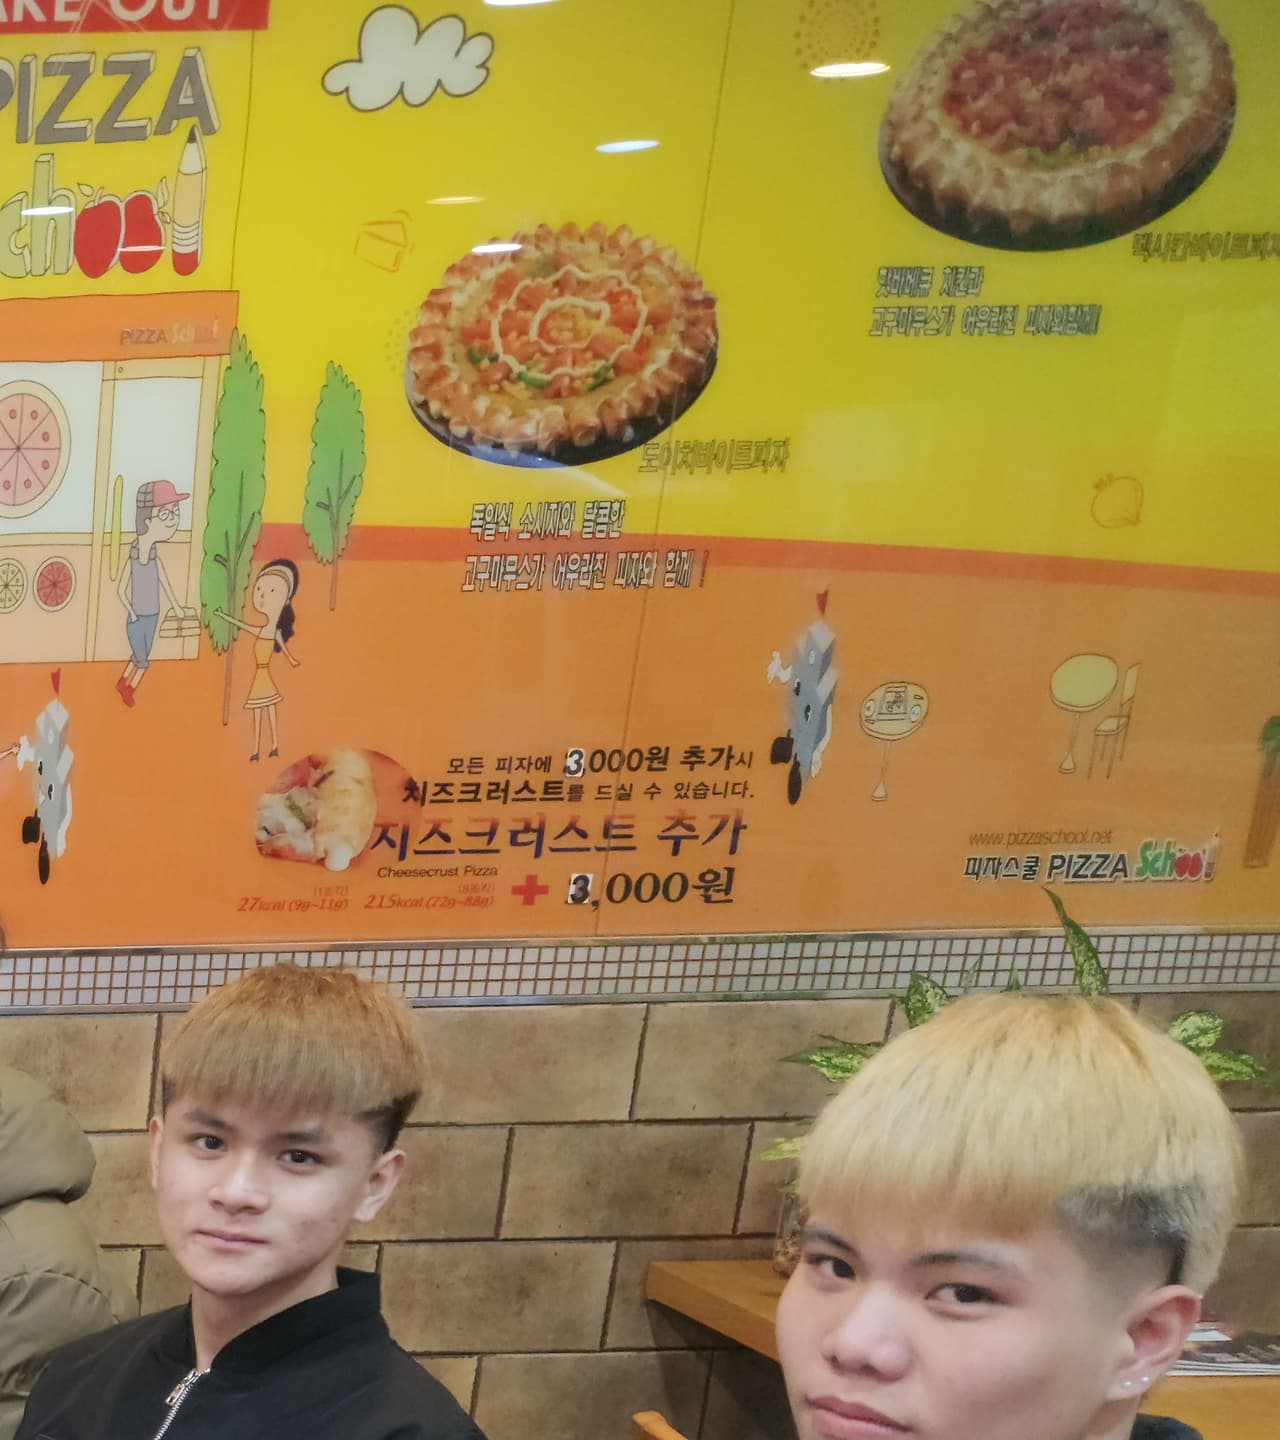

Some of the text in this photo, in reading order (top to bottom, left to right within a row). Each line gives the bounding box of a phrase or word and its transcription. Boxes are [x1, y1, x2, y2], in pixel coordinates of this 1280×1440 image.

[939, 266, 984, 297] 치킨과
[869, 305, 955, 336] 고구마무스가
[961, 305, 1019, 336] 어우러진
[119, 328, 167, 346] PIZZA
[638, 437, 790, 475] 도이치바이트피자
[469, 499, 626, 541] 독일식 소시지와 달콤한
[461, 552, 546, 592] 고구마무스가
[552, 551, 607, 590] 어우러진
[614, 550, 658, 589] 피자와
[447, 756, 485, 775] 모든
[495, 754, 552, 774] 피자에
[679, 745, 754, 773] 추가시
[403, 778, 755, 807] 치즈크러스트를 드실 수 있습니다.
[657, 807, 748, 857] 추가
[969, 828, 1113, 848] www.pizzaschool.net
[377, 865, 499, 878] Cheesecrust Pizza
[963, 855, 1040, 881] 피자스쿨
[1046, 853, 1129, 880] PIZZA
[567, 867, 736, 912] 3,000원
